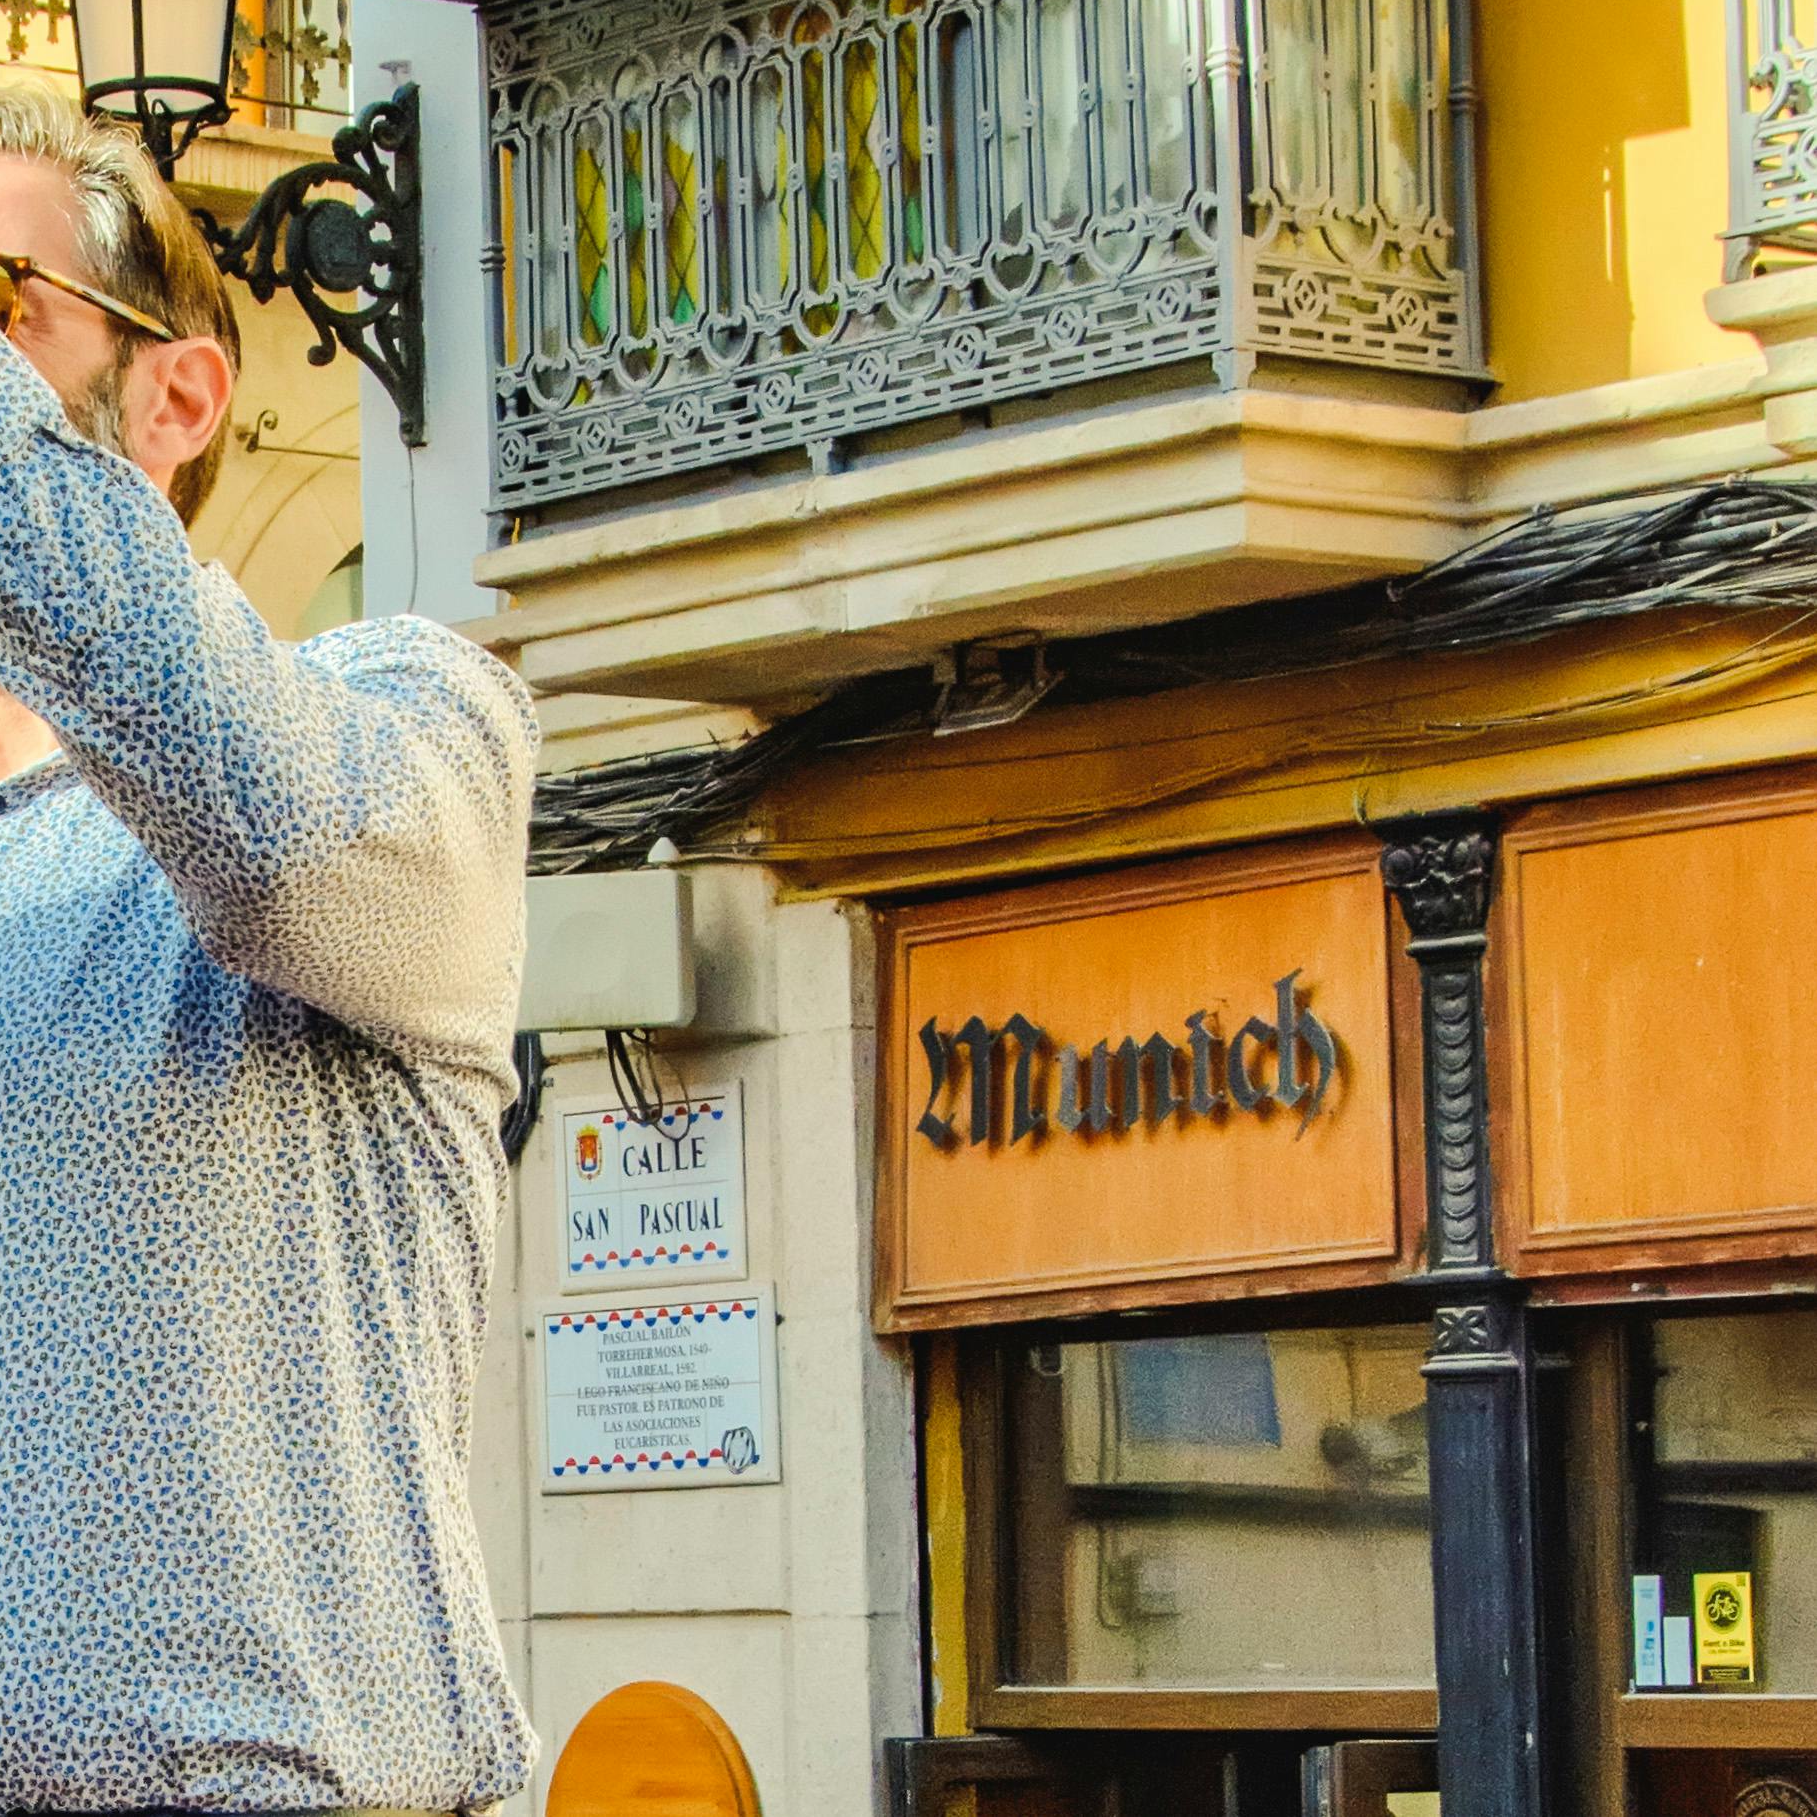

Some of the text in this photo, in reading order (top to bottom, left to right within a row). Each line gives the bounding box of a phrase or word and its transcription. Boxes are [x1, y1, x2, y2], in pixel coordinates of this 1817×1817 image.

[915, 966, 1337, 1148] Munich
[622, 1135, 709, 1178] CALLE
[572, 1196, 724, 1242] SAN PASCUAL
[602, 1329, 650, 1346] PASCUAL
[605, 1363, 674, 1379] VILLARREAL,
[577, 1375, 730, 1399] LEGO FRANCISCANO DE NIÑO
[576, 1404, 597, 1417] FUE
[643, 1399, 656, 1413] ES
[657, 1397, 707, 1412] PATRONO
[709, 1394, 725, 1408] DE
[603, 1415, 702, 1433] LAS ASOCIACIONES
